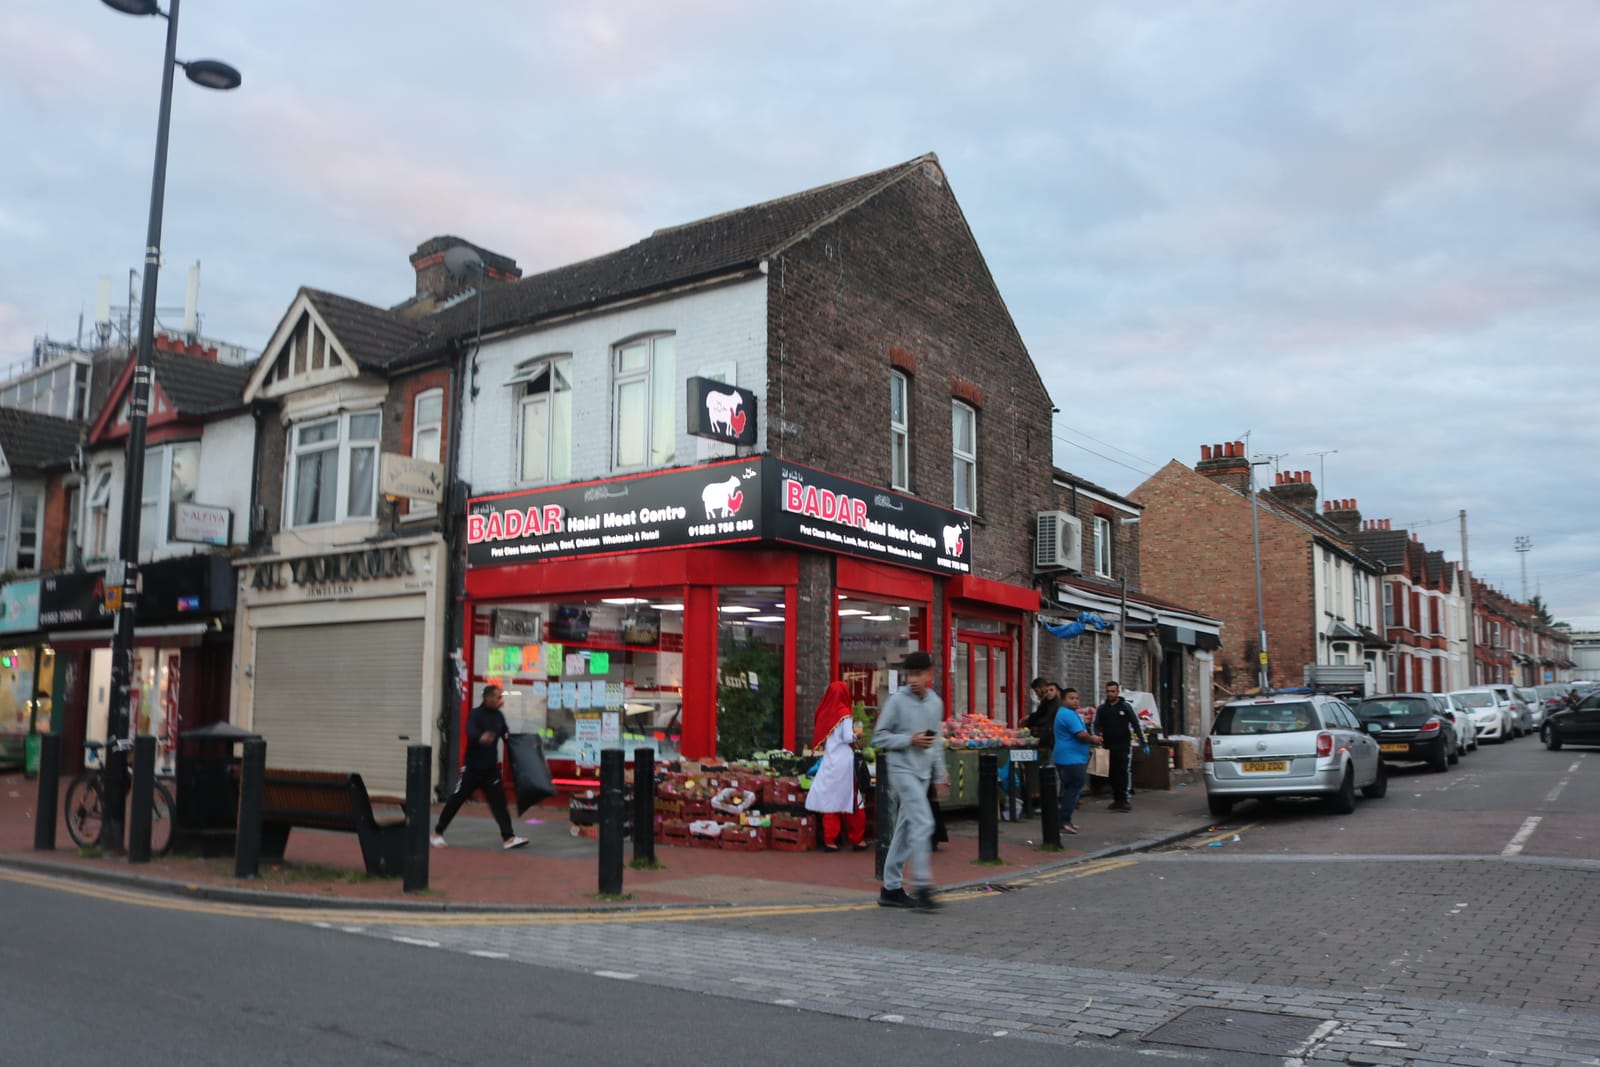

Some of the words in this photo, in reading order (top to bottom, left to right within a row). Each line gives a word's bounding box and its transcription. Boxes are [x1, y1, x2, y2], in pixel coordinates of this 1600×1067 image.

[467, 504, 565, 544] BADAR
[567, 514, 600, 532] Halal
[603, 510, 637, 528] Meat
[640, 506, 686, 523] Centre
[781, 479, 867, 529] BADAR
[864, 518, 886, 536] Halal
[888, 523, 909, 541] Meat
[909, 529, 936, 548] Centre
[491, 547, 504, 557] First
[504, 546, 519, 556] Class
[576, 538, 600, 548] Chicken
[602, 533, 634, 545] Wholesale
[635, 532, 640, 541] &
[641, 530, 660, 540] Retail
[306, 584, 354, 598] JEWELLERS
